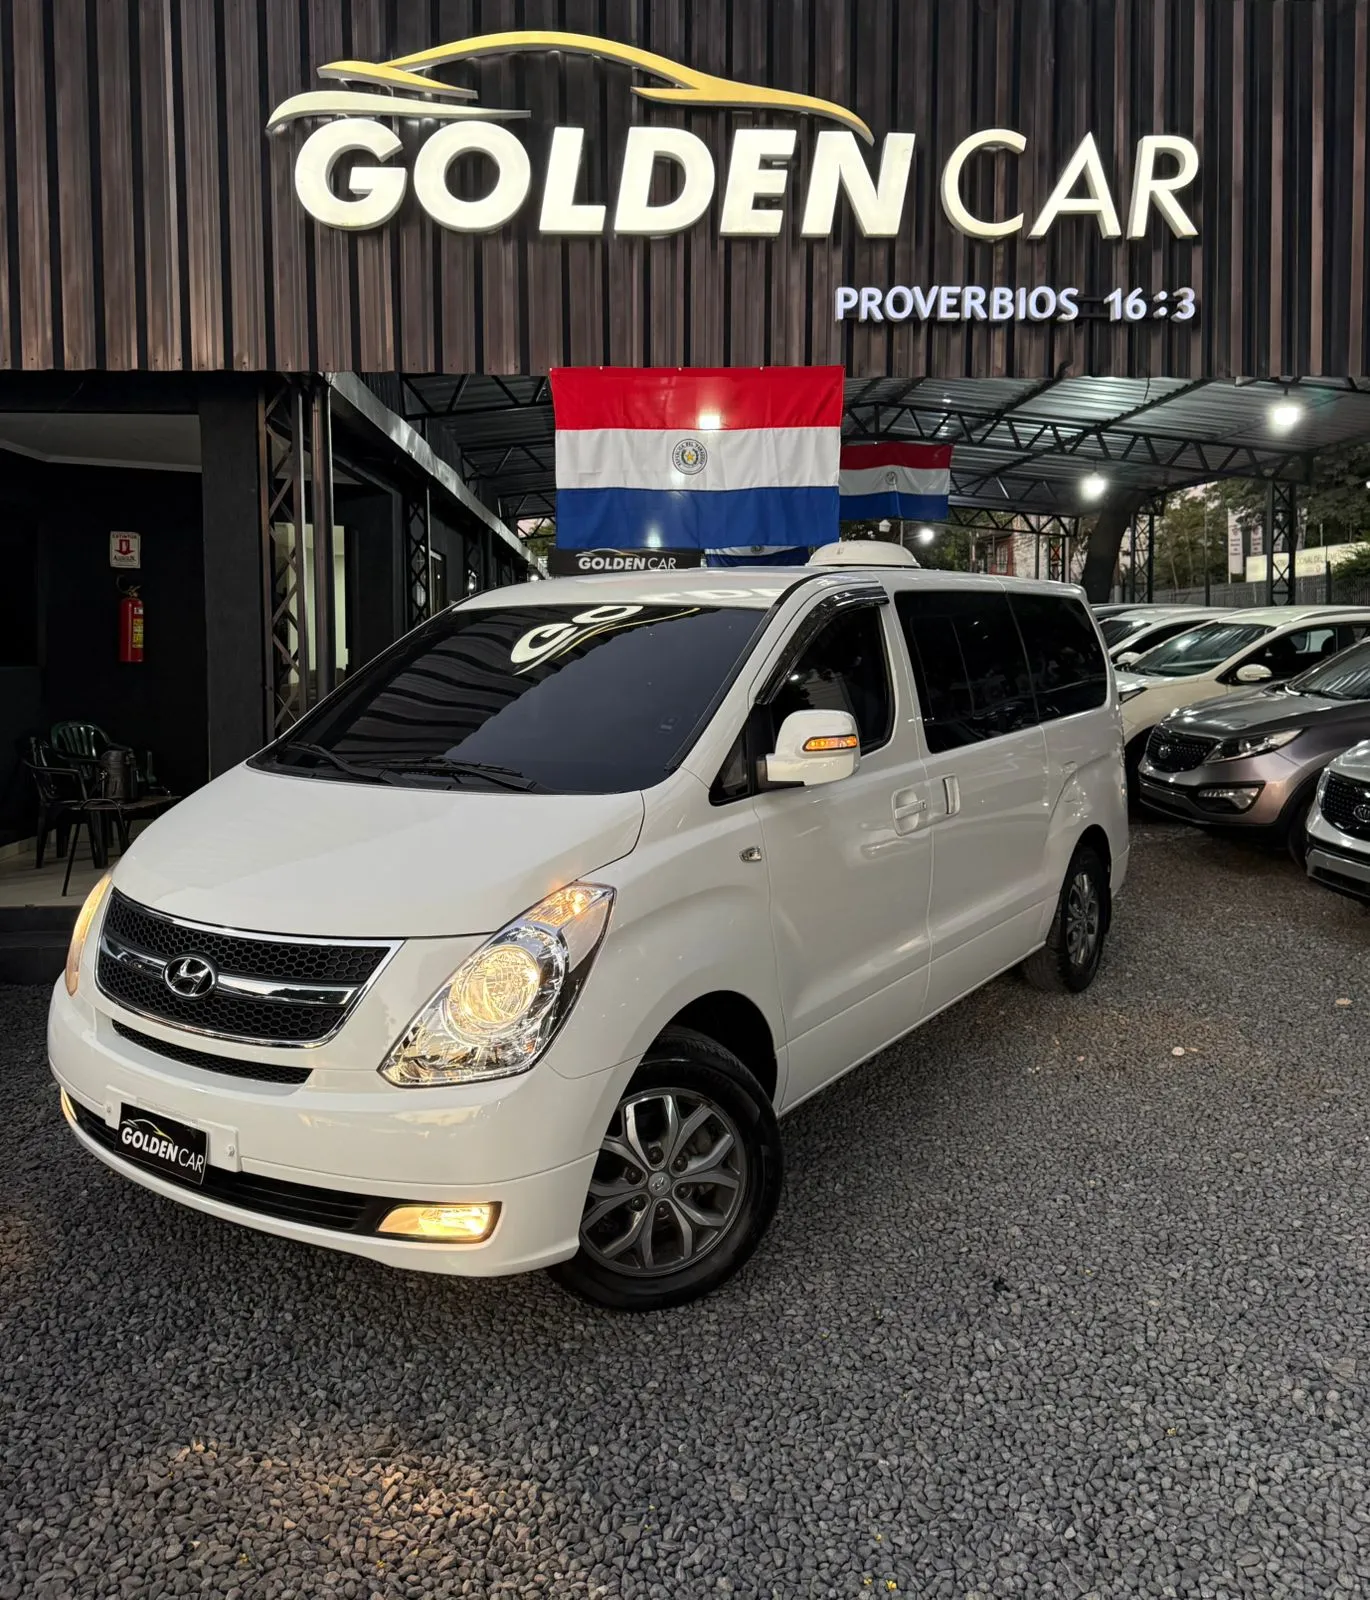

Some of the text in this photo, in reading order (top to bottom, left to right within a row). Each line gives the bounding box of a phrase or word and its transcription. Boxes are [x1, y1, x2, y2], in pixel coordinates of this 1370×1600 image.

[294, 117, 1199, 242] GOLDEN CAR
[835, 285, 1196, 322] PROVERBIOS 16:3
[578, 557, 677, 570] GOLDEN CAR
[121, 1127, 204, 1174] GOLDEN CAR
